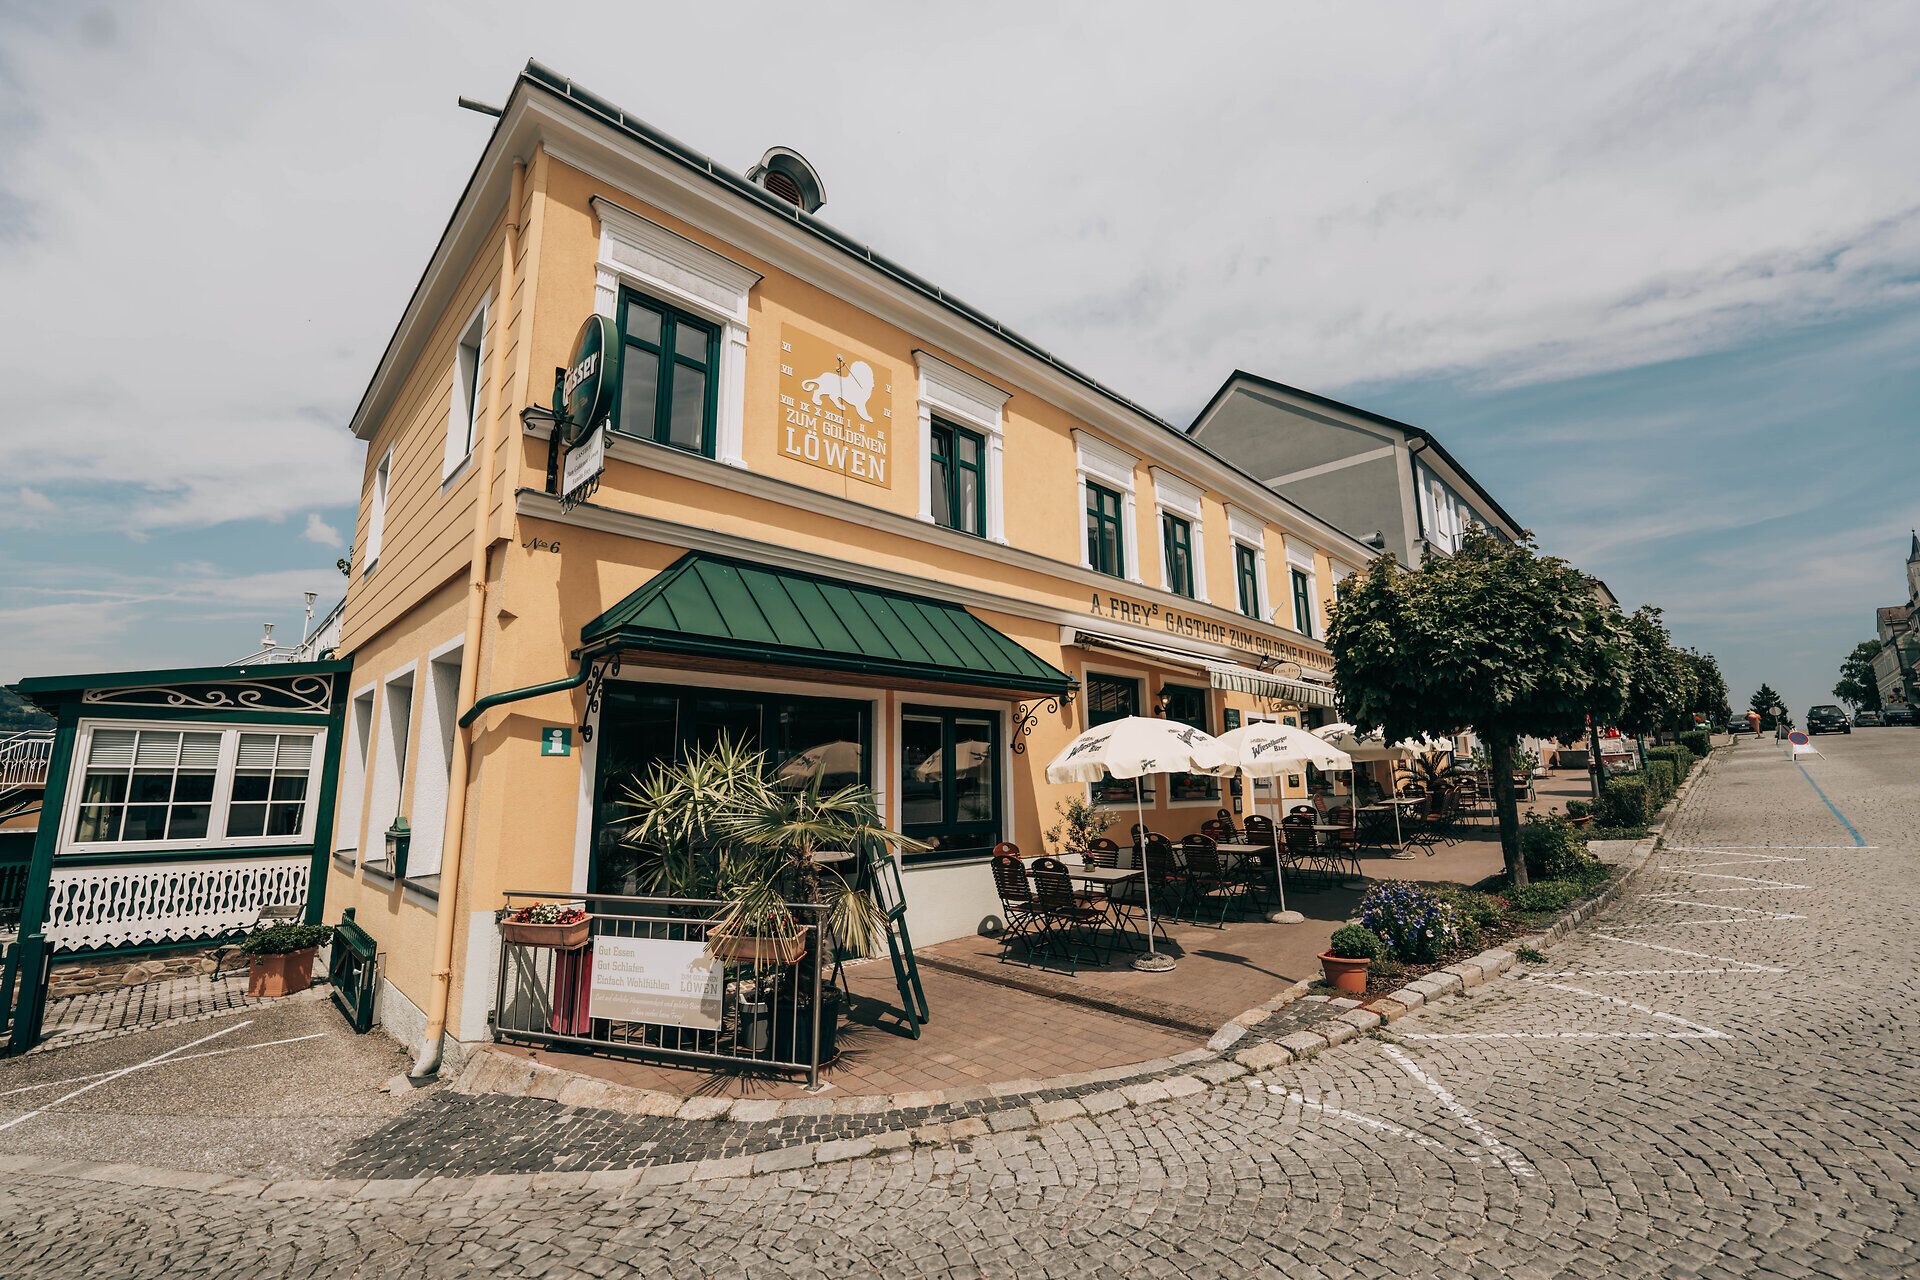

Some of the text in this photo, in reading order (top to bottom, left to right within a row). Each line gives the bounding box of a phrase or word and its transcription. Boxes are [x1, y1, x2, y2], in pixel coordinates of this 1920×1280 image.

[786, 408, 887, 455] ZUM GOLDENEN
[785, 426, 886, 483] LÖWEN
[550, 542, 560, 553] 6
[1166, 612, 1226, 644] GASTHOF
[1230, 629, 1253, 651] ZUM
[598, 945, 635, 957] Gut Essen
[597, 960, 644, 973] Gut Schlafen
[596, 974, 670, 990] Einfach Wohlfühlen
